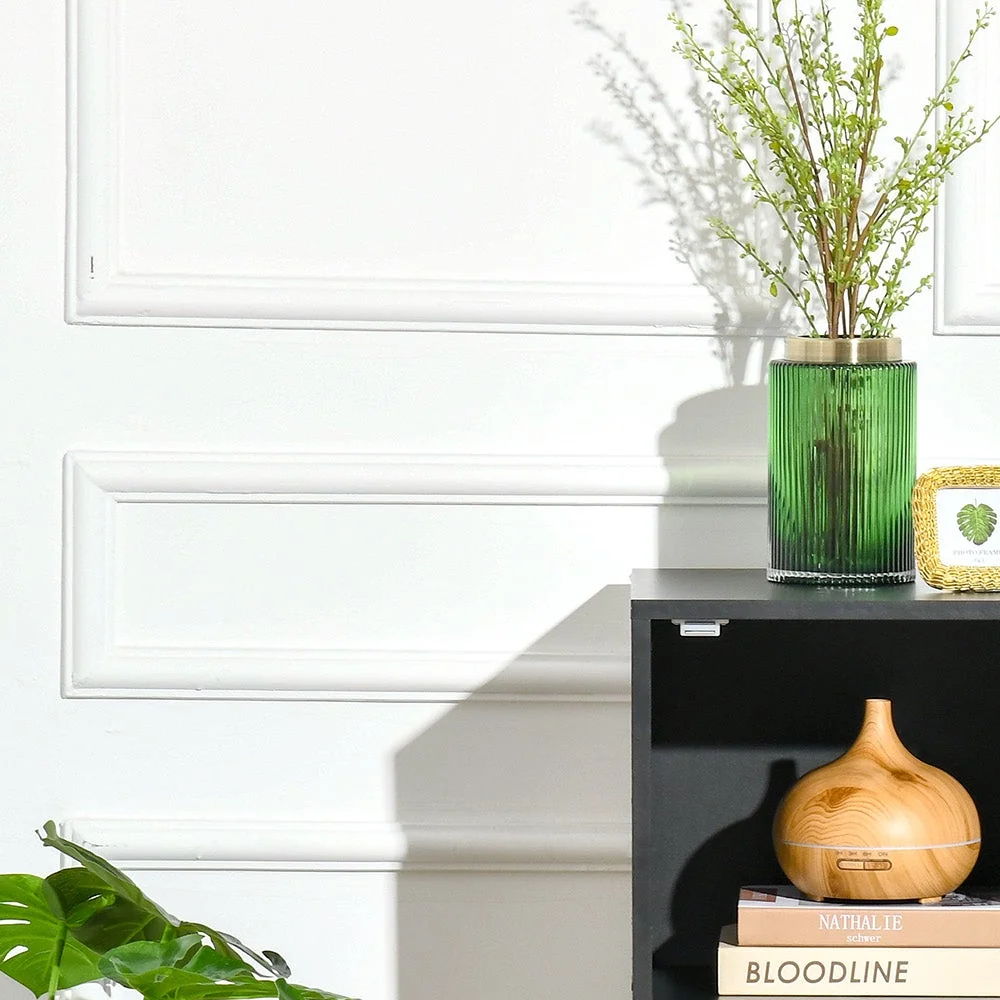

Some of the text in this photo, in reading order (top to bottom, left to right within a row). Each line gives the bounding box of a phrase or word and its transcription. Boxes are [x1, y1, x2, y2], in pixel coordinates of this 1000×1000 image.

[818, 913, 903, 931] NATHALIE
[846, 933, 882, 943] schwer
[746, 960, 909, 984] BLOODLINE
